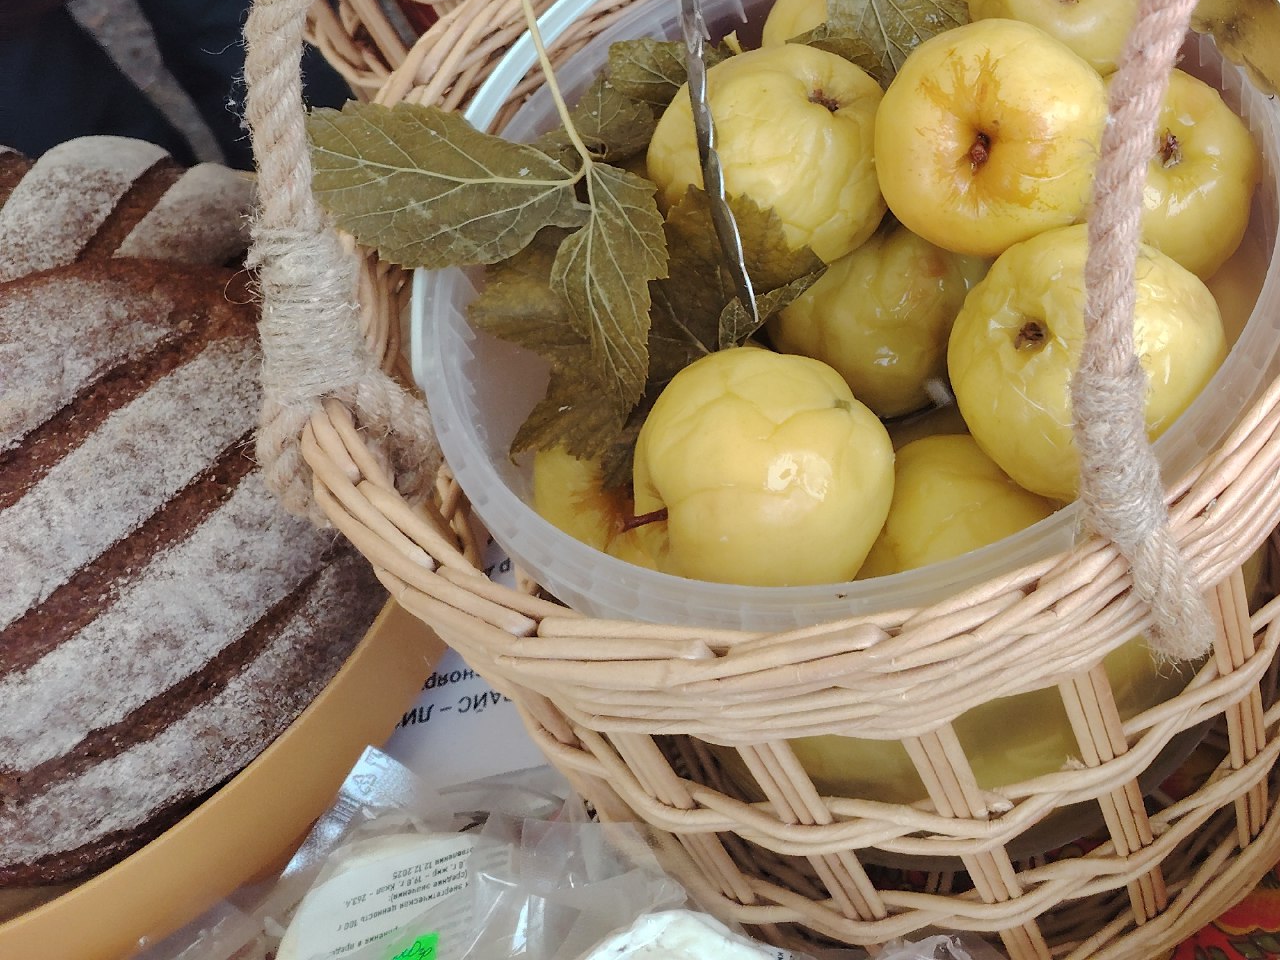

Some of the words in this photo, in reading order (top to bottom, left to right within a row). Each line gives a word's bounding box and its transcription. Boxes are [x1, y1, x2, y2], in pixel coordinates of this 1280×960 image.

[422, 669, 481, 691] нояр
[395, 704, 434, 730] ЛИ
[432, 869, 468, 888] (средние
[399, 883, 463, 909] энергетическая
[360, 904, 397, 922] ценность
[343, 920, 358, 931] 100
